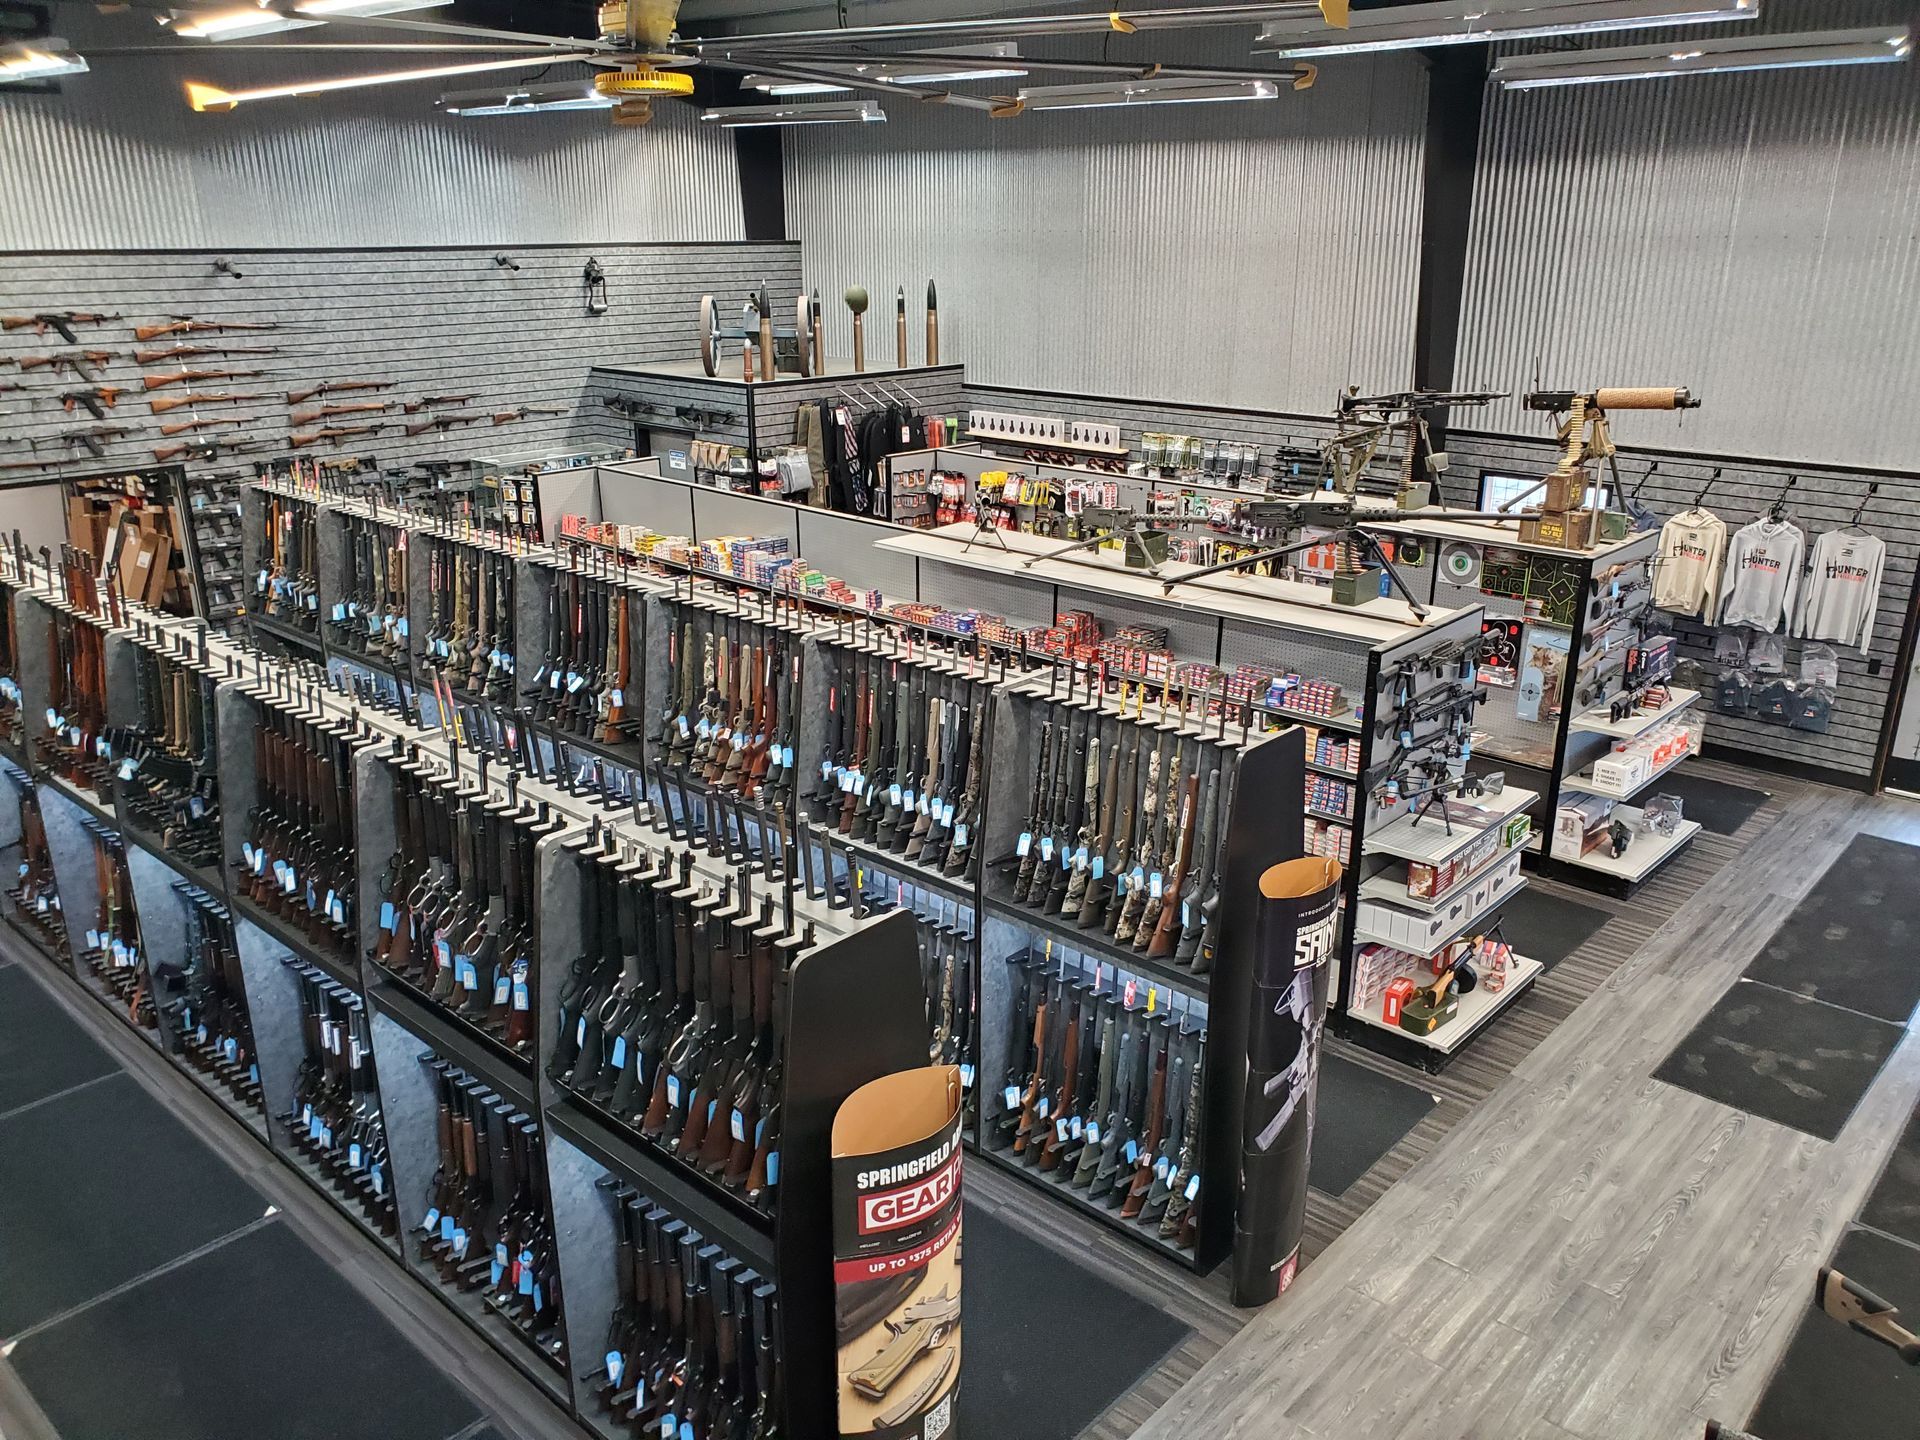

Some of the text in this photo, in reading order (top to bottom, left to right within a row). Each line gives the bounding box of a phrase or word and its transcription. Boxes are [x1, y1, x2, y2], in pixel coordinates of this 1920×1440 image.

[1673, 537, 1706, 557] HUNTER
[1742, 549, 1780, 569] HUNTER
[1826, 557, 1868, 579] HUNTER
[857, 1141, 949, 1189] SPRINGFIELD
[871, 1174, 949, 1222] GEAR
[869, 1263, 886, 1273] UP
[889, 1258, 906, 1269] TO
[909, 1247, 931, 1262] $375
